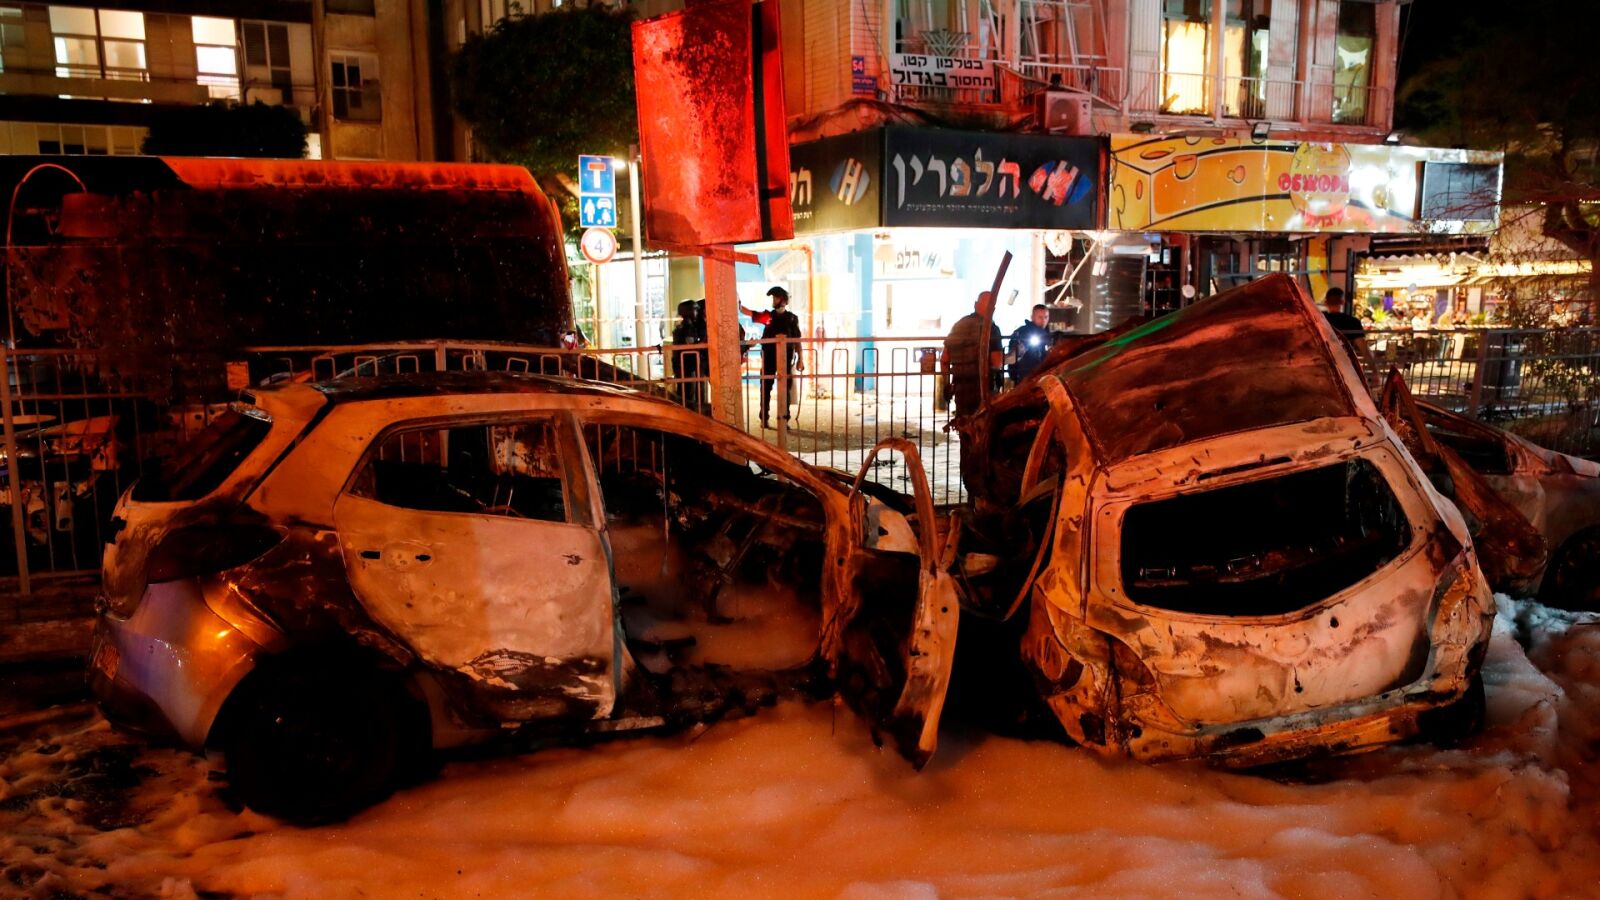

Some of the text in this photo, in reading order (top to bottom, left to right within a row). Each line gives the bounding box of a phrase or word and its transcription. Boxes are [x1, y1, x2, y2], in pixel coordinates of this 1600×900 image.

[936, 57, 984, 70] בטלפון
[892, 69, 948, 87] בגדול
[949, 74, 993, 87] תחסוך
[892, 147, 1021, 209] הלפרין
[594, 239, 604, 253] 4
